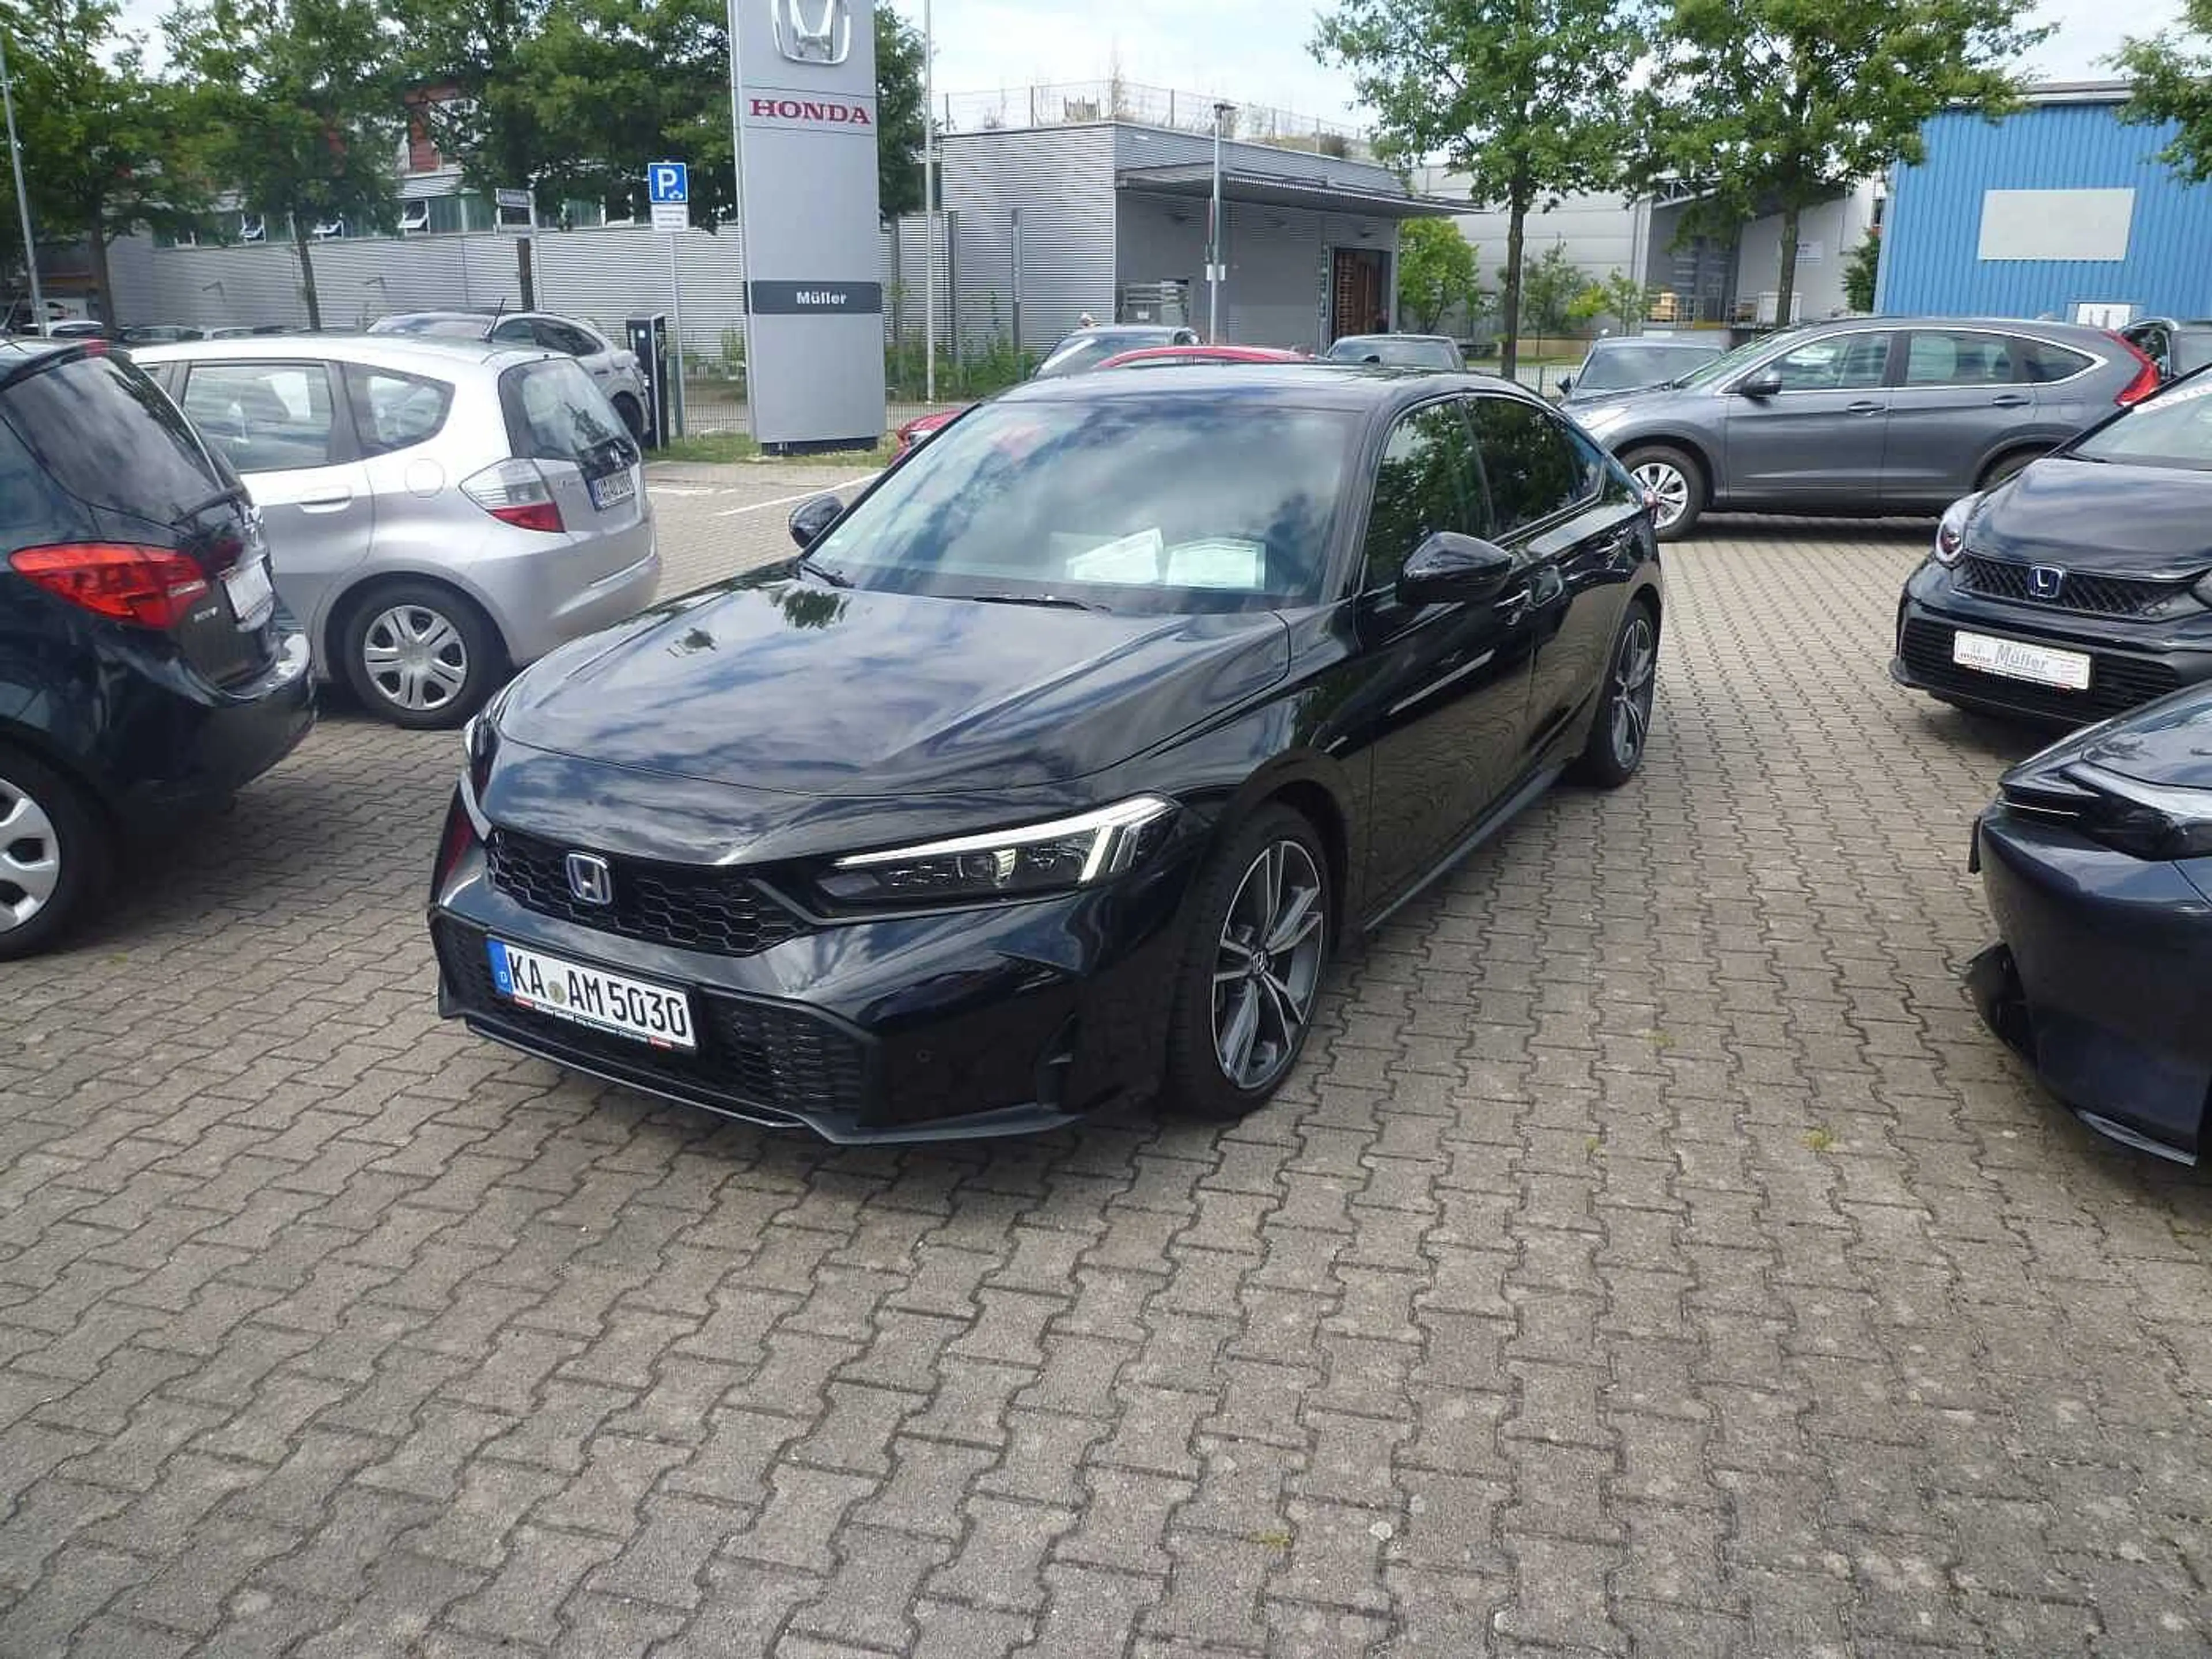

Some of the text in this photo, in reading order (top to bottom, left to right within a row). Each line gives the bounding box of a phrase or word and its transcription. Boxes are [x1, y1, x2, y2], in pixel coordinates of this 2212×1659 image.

[749, 99, 872, 125] HONDA
[657, 169, 677, 198] P
[796, 291, 847, 305] Müller
[507, 952, 546, 998] KA
